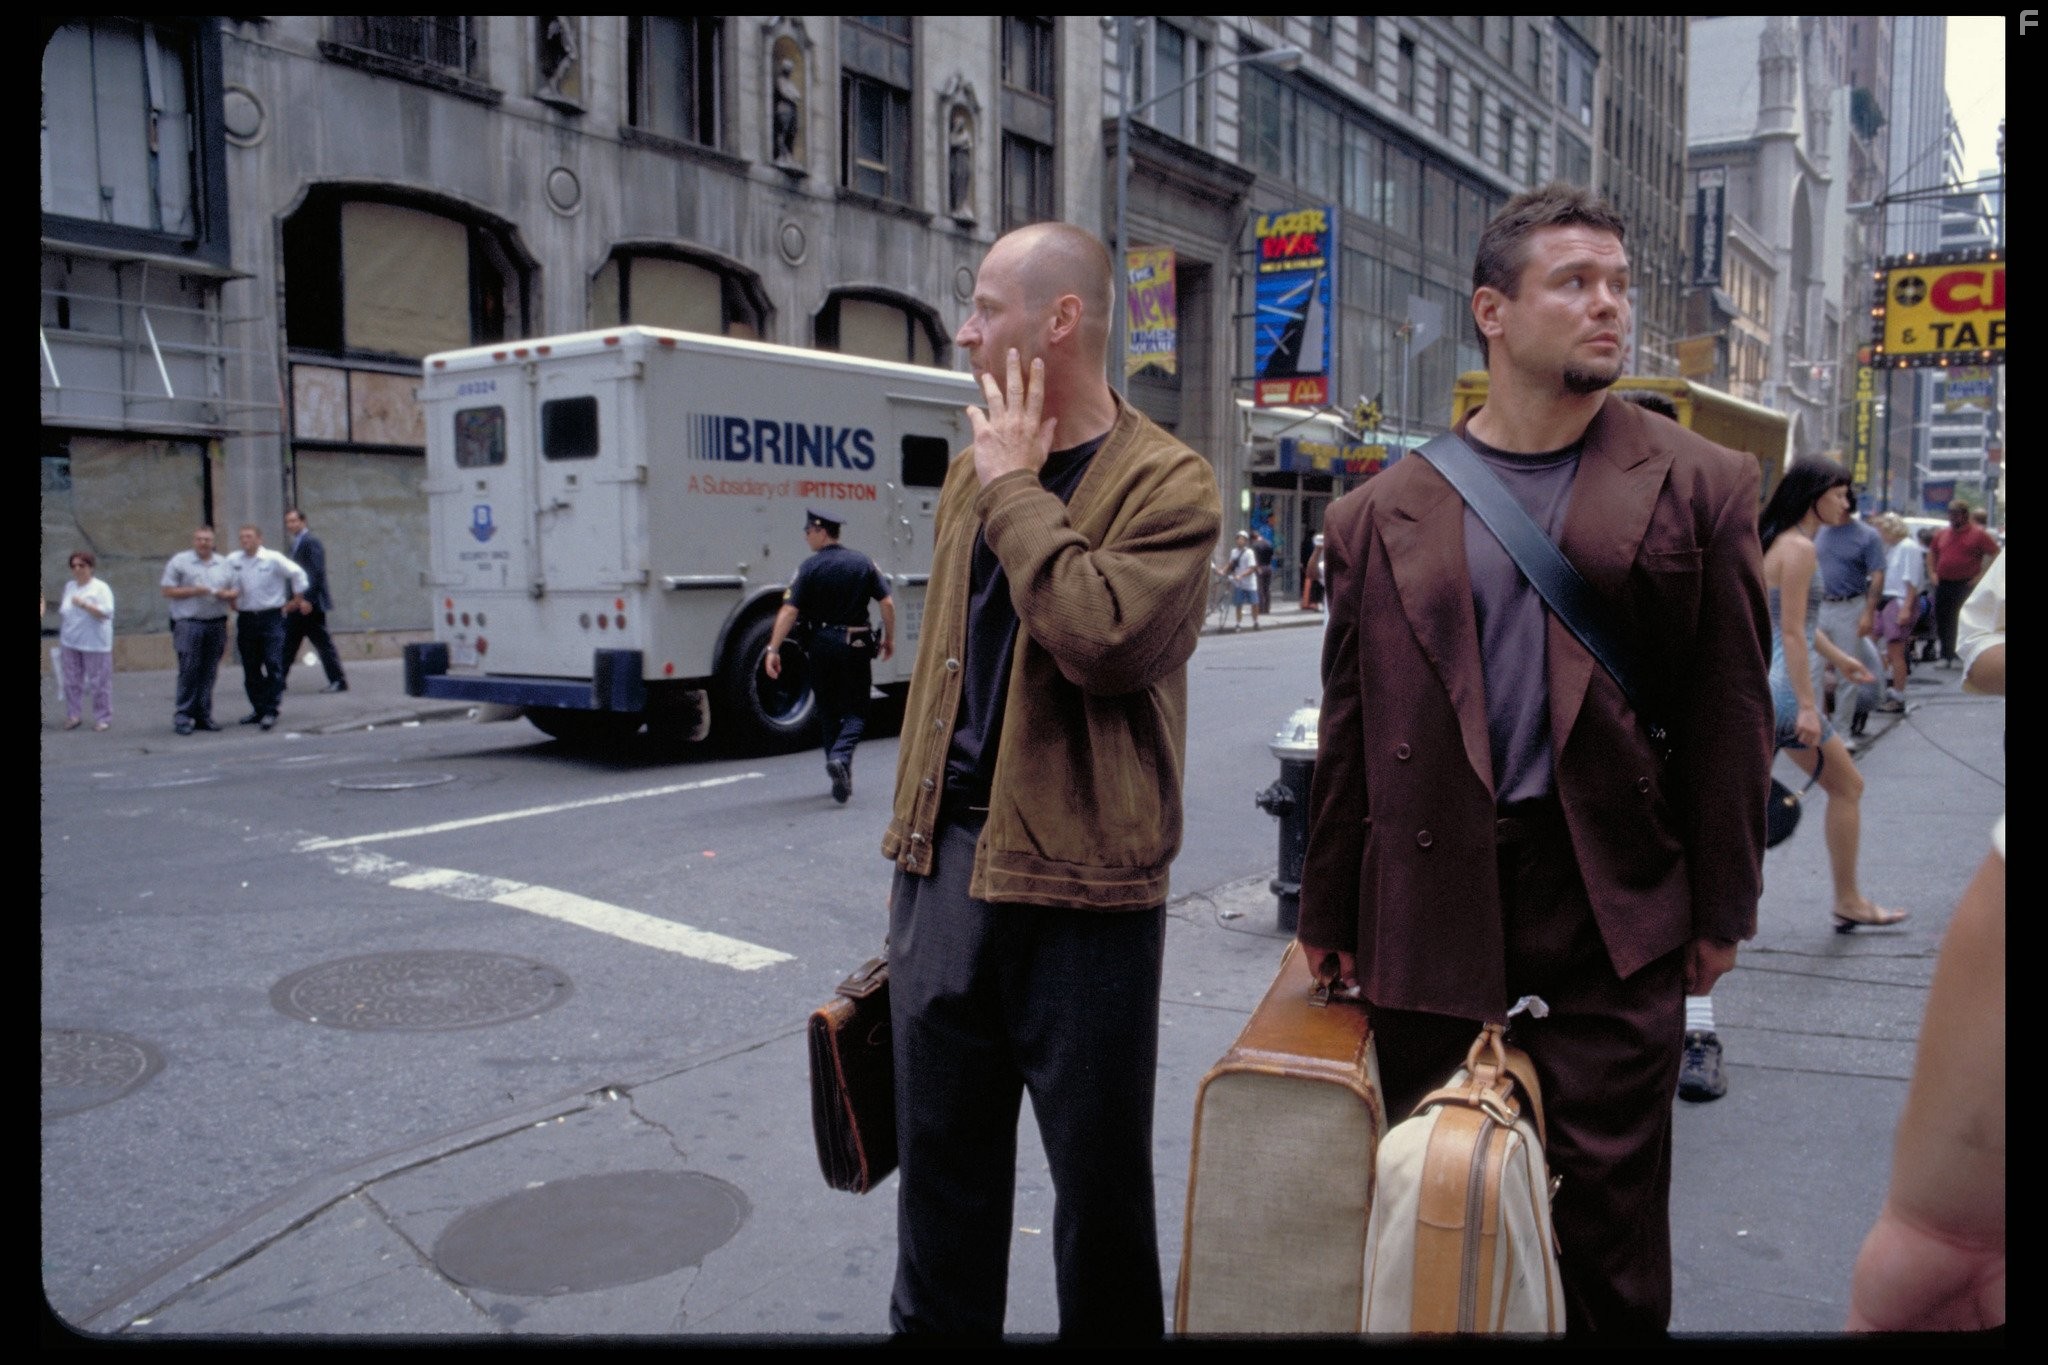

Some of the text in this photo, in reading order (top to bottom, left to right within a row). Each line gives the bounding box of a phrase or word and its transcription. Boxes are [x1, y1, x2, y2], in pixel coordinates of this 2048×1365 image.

[1255, 208, 1327, 239] LAZER
[1902, 327, 1917, 345] &
[723, 416, 876, 471] BRINKS
[688, 474, 699, 494] A
[805, 480, 877, 501] PITTSTON
